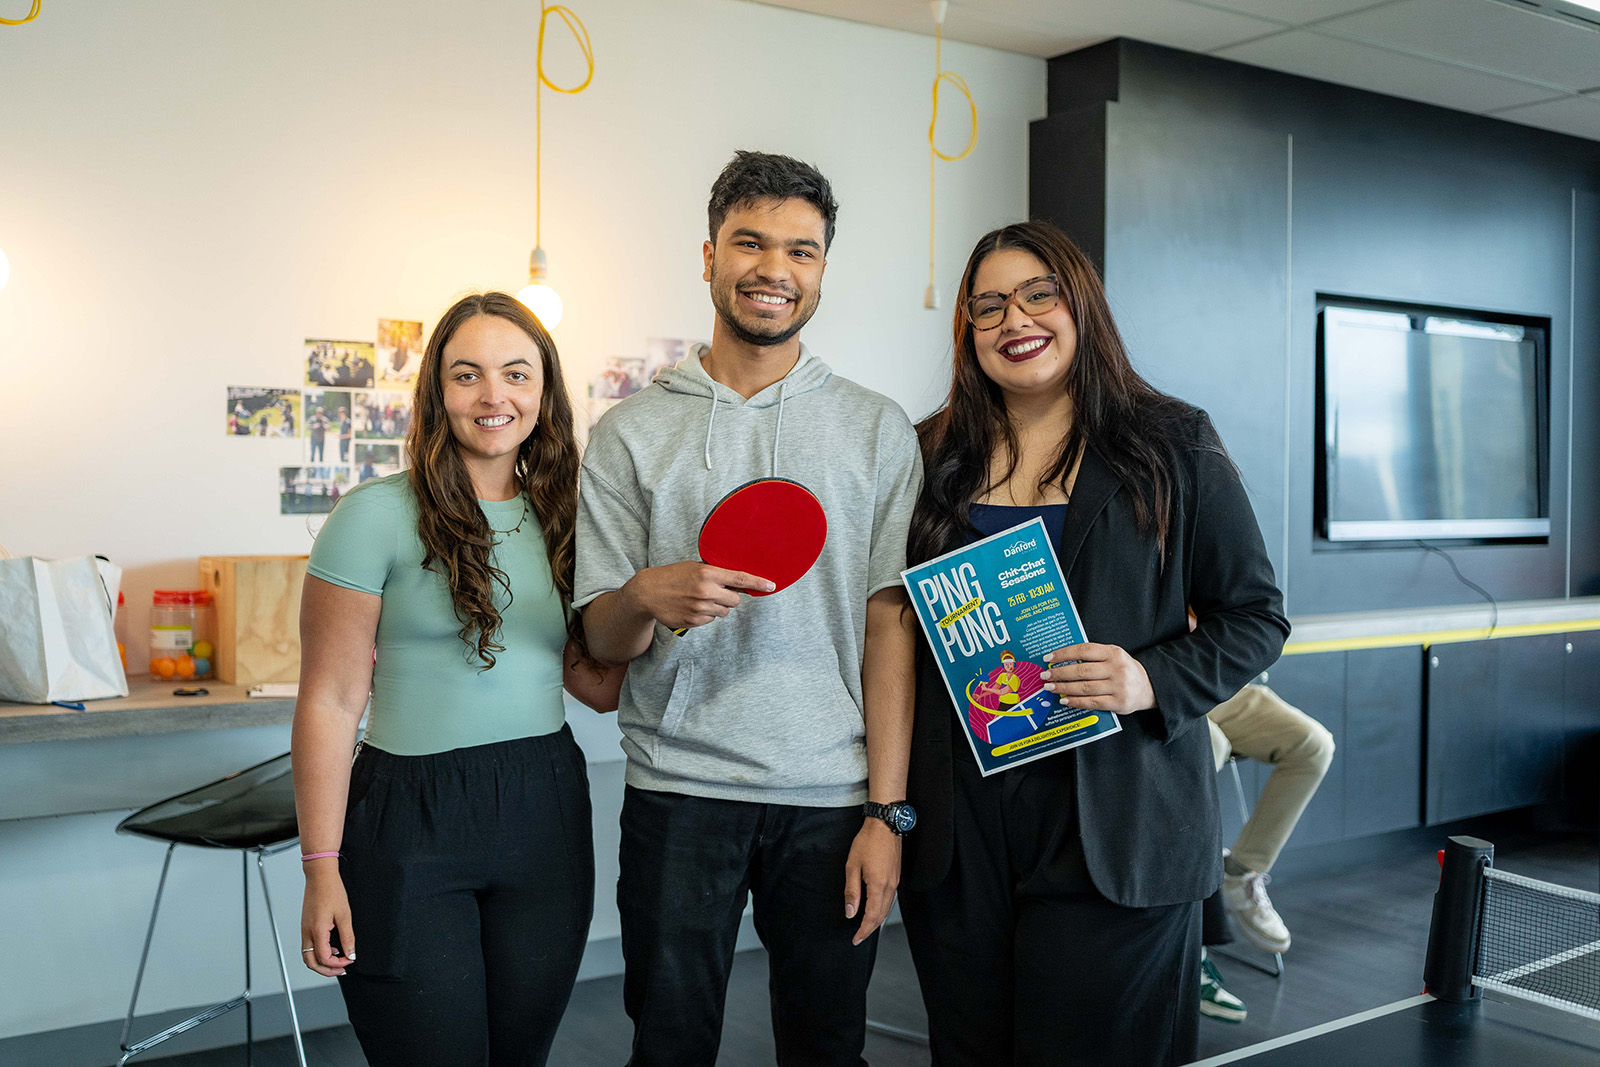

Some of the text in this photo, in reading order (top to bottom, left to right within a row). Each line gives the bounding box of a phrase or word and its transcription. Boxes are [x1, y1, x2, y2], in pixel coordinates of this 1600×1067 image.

[1003, 538, 1037, 558] Danford
[998, 557, 1046, 580] Chit-Chat
[1000, 567, 1046, 589] Sessions
[918, 562, 985, 621] PING
[1007, 596, 1016, 607] 25
[1015, 592, 1026, 604] FEB
[1044, 581, 1055, 593] AM
[941, 598, 979, 626] TOURNAMENT
[1020, 607, 1031, 615] JOIN
[935, 601, 1011, 663] PONG
[1033, 731, 1056, 743] DELIGHTFUL
